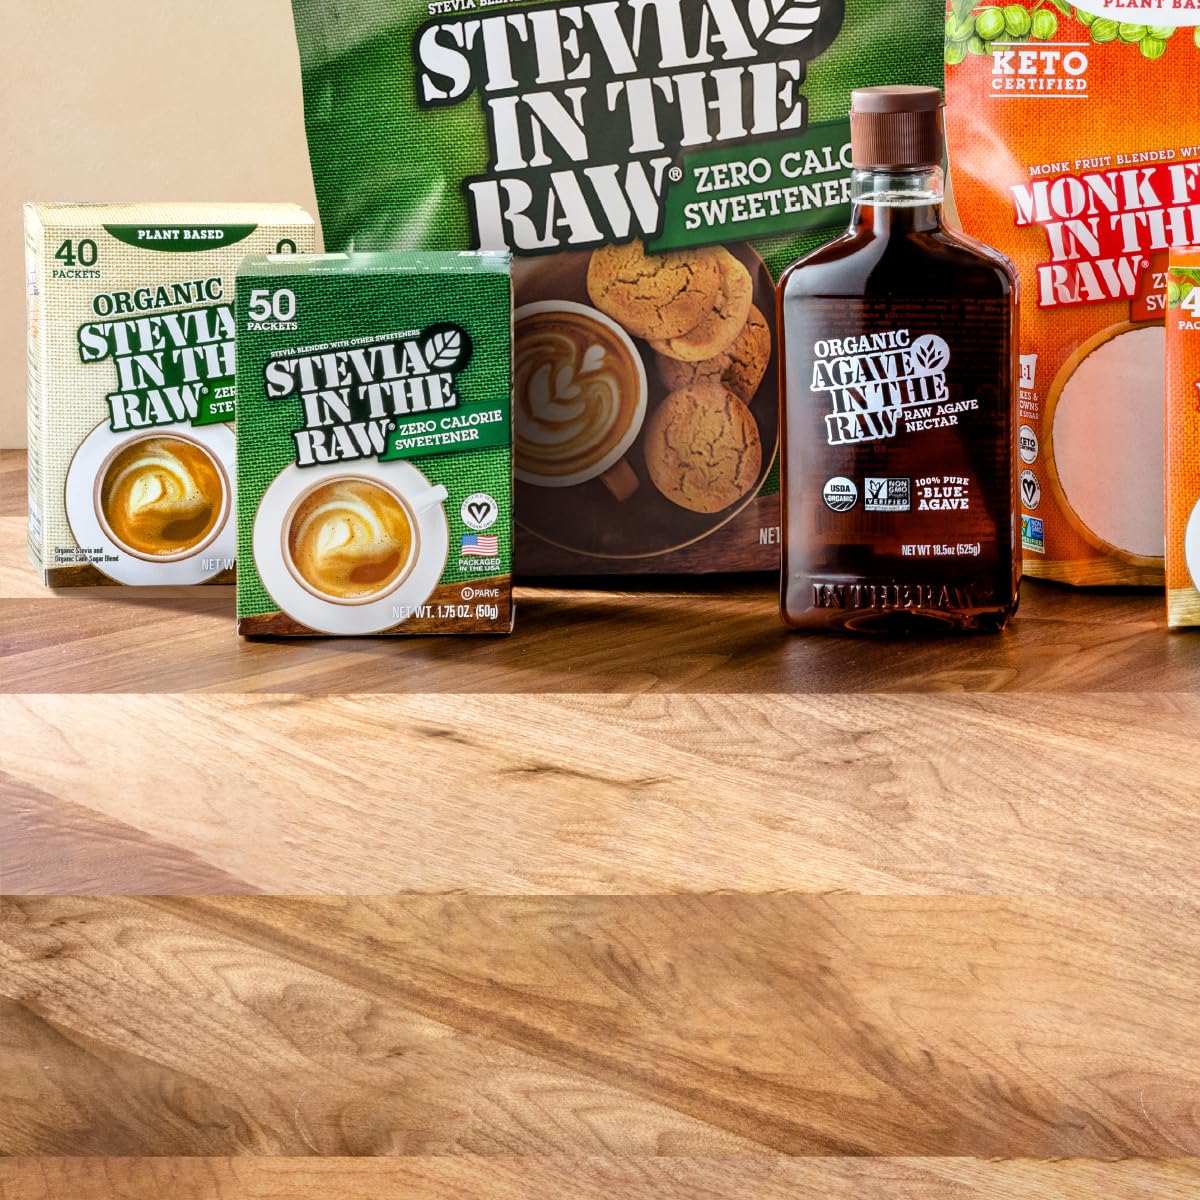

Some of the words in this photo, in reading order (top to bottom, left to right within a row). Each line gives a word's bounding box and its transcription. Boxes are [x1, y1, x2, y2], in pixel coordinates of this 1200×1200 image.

[991, 50, 1089, 76] KETO
[991, 78, 1088, 91] CERTIFIED
[488, 87, 589, 172] IN
[606, 59, 802, 154] THE
[693, 157, 772, 194] ZERO
[1029, 161, 1070, 176] MONK
[1075, 157, 1112, 171] FRUIT
[1117, 149, 1176, 165] BLENDED
[684, 178, 852, 230] SWEETENER
[1010, 167, 1163, 225] MONK
[138, 230, 180, 240] PLANT
[183, 230, 224, 240] BASED
[1046, 218, 1101, 262] IN
[55, 239, 98, 267] 40
[52, 270, 101, 279] PACKETS
[93, 277, 223, 316] ORGANIC
[248, 288, 296, 321] 50
[80, 307, 235, 361] STEVIA
[247, 322, 298, 331] PACKETS
[270, 348, 295, 358] STEVIA
[297, 343, 329, 355] BLENDED
[330, 339, 349, 349] WITH
[350, 336, 375, 347] OTHER
[814, 329, 910, 358] ORGANIC
[116, 351, 165, 391] IN
[265, 341, 430, 397] STEVIA
[812, 350, 916, 389] AGAVE
[302, 387, 351, 428] IN
[360, 373, 456, 419] THE
[832, 384, 870, 414] IN
[874, 373, 947, 408] THE
[399, 421, 437, 436] ZERO
[440, 410, 502, 430] CALORIE
[904, 406, 932, 421] RAW
[936, 399, 979, 416] AGAVE
[905, 415, 958, 432] NECTAR
[395, 429, 479, 450] SWEETENER
[830, 484, 851, 493] USDA
[915, 477, 940, 487] 100%
[943, 476, 969, 485] PURE
[918, 499, 969, 511] AGAVE
[458, 558, 500, 566] PACKAGED
[902, 544, 917, 556] NET
[917, 544, 932, 556] WT
[932, 544, 955, 555] 18.5oz
[201, 559, 221, 571] NET
[474, 589, 499, 598] PARVE
[392, 606, 411, 618] NET
[415, 606, 435, 618] WT.
[437, 605, 455, 618] 1.75
[457, 605, 473, 617] OZ.
